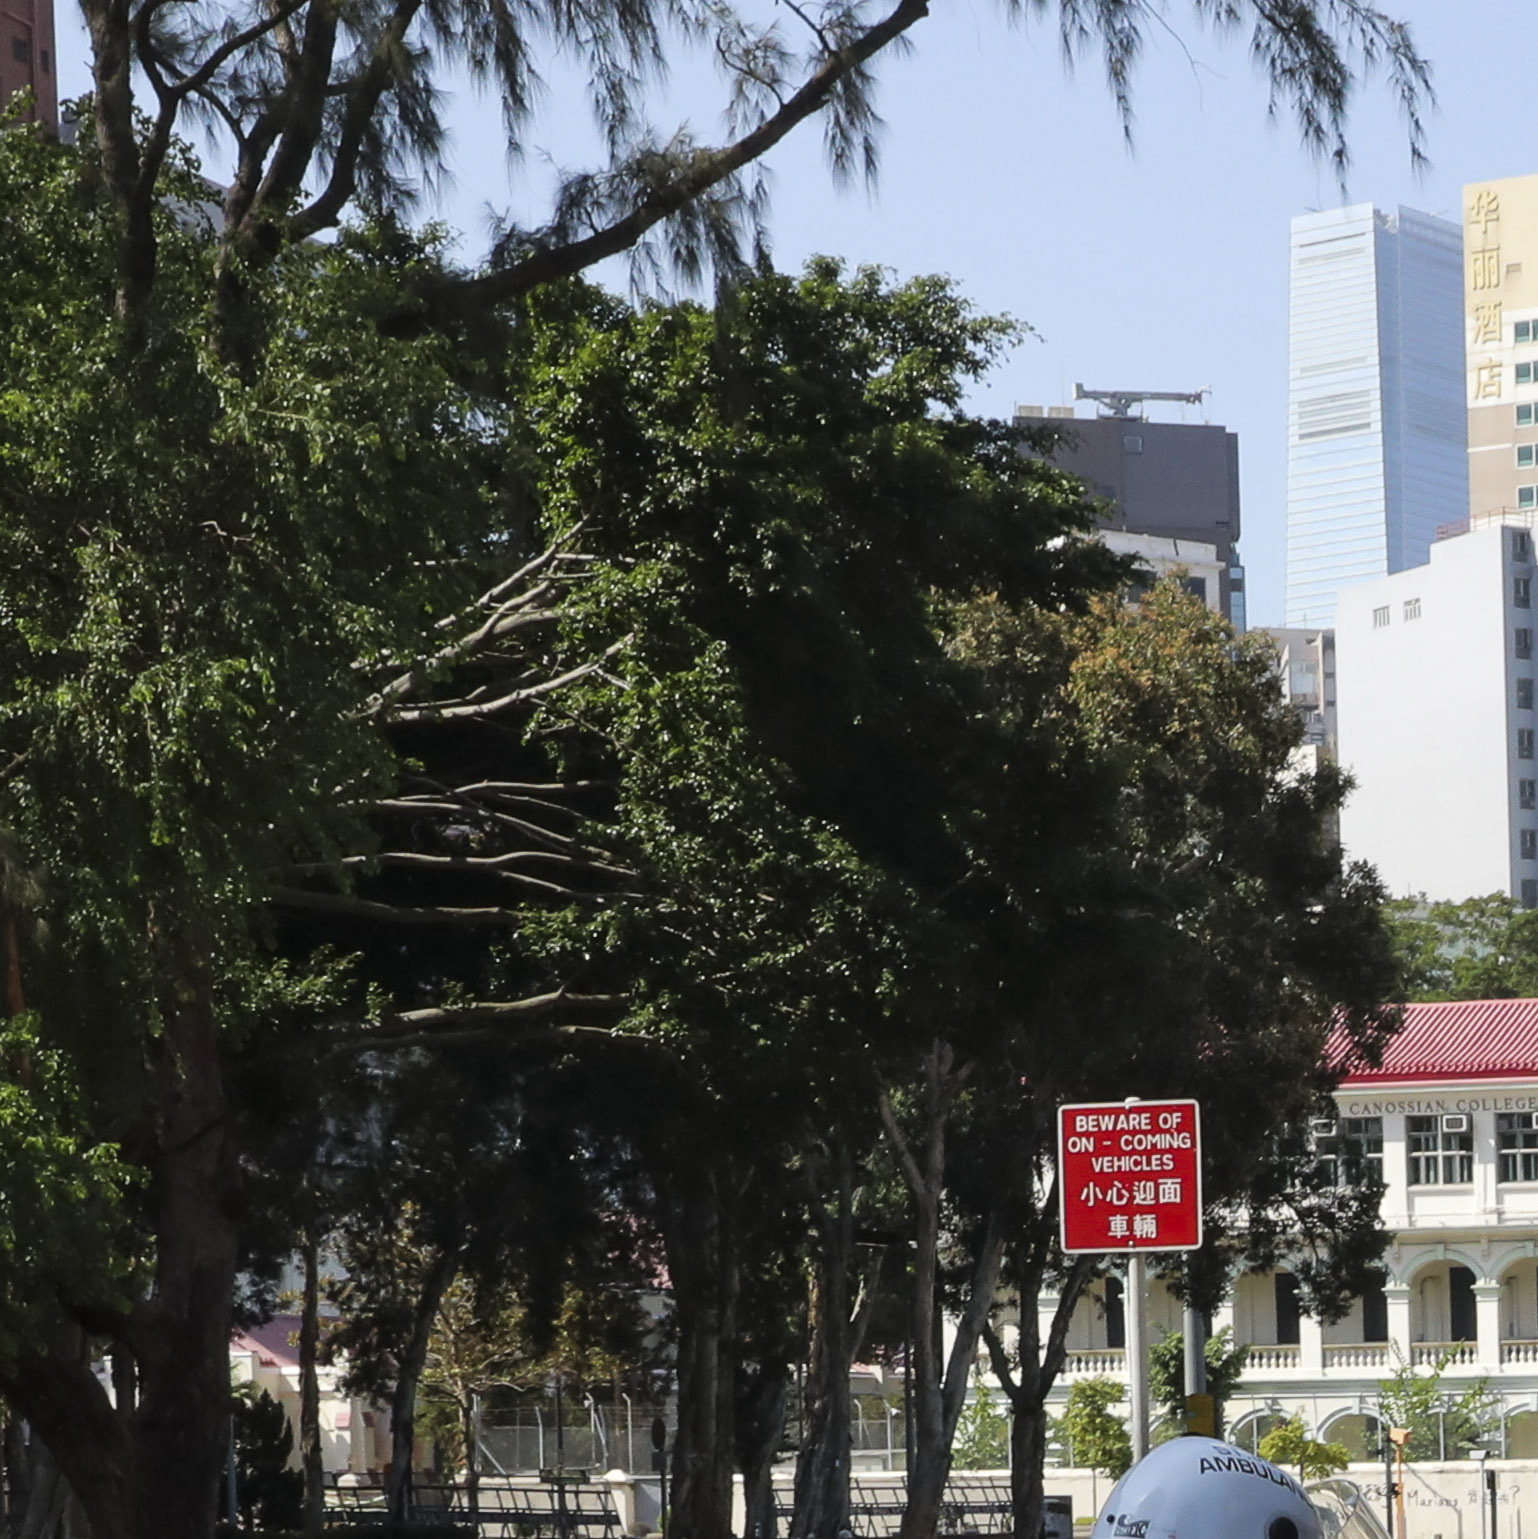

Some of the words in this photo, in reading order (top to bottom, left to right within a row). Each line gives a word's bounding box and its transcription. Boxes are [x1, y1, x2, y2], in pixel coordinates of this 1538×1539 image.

[1470, 190, 1503, 401] 华丽酒店
[1350, 1101, 1446, 1116] CANOSSIAN
[1456, 1096, 1538, 1112] COLLEGE
[1075, 1113, 1151, 1132] BEWARE
[1158, 1112, 1182, 1130] OF
[1067, 1136, 1095, 1153] ON
[1120, 1132, 1191, 1151] COMING
[1091, 1153, 1175, 1173] VEHICLES
[1080, 1178, 1182, 1207] 小心迎面
[1107, 1214, 1157, 1239] 車輛
